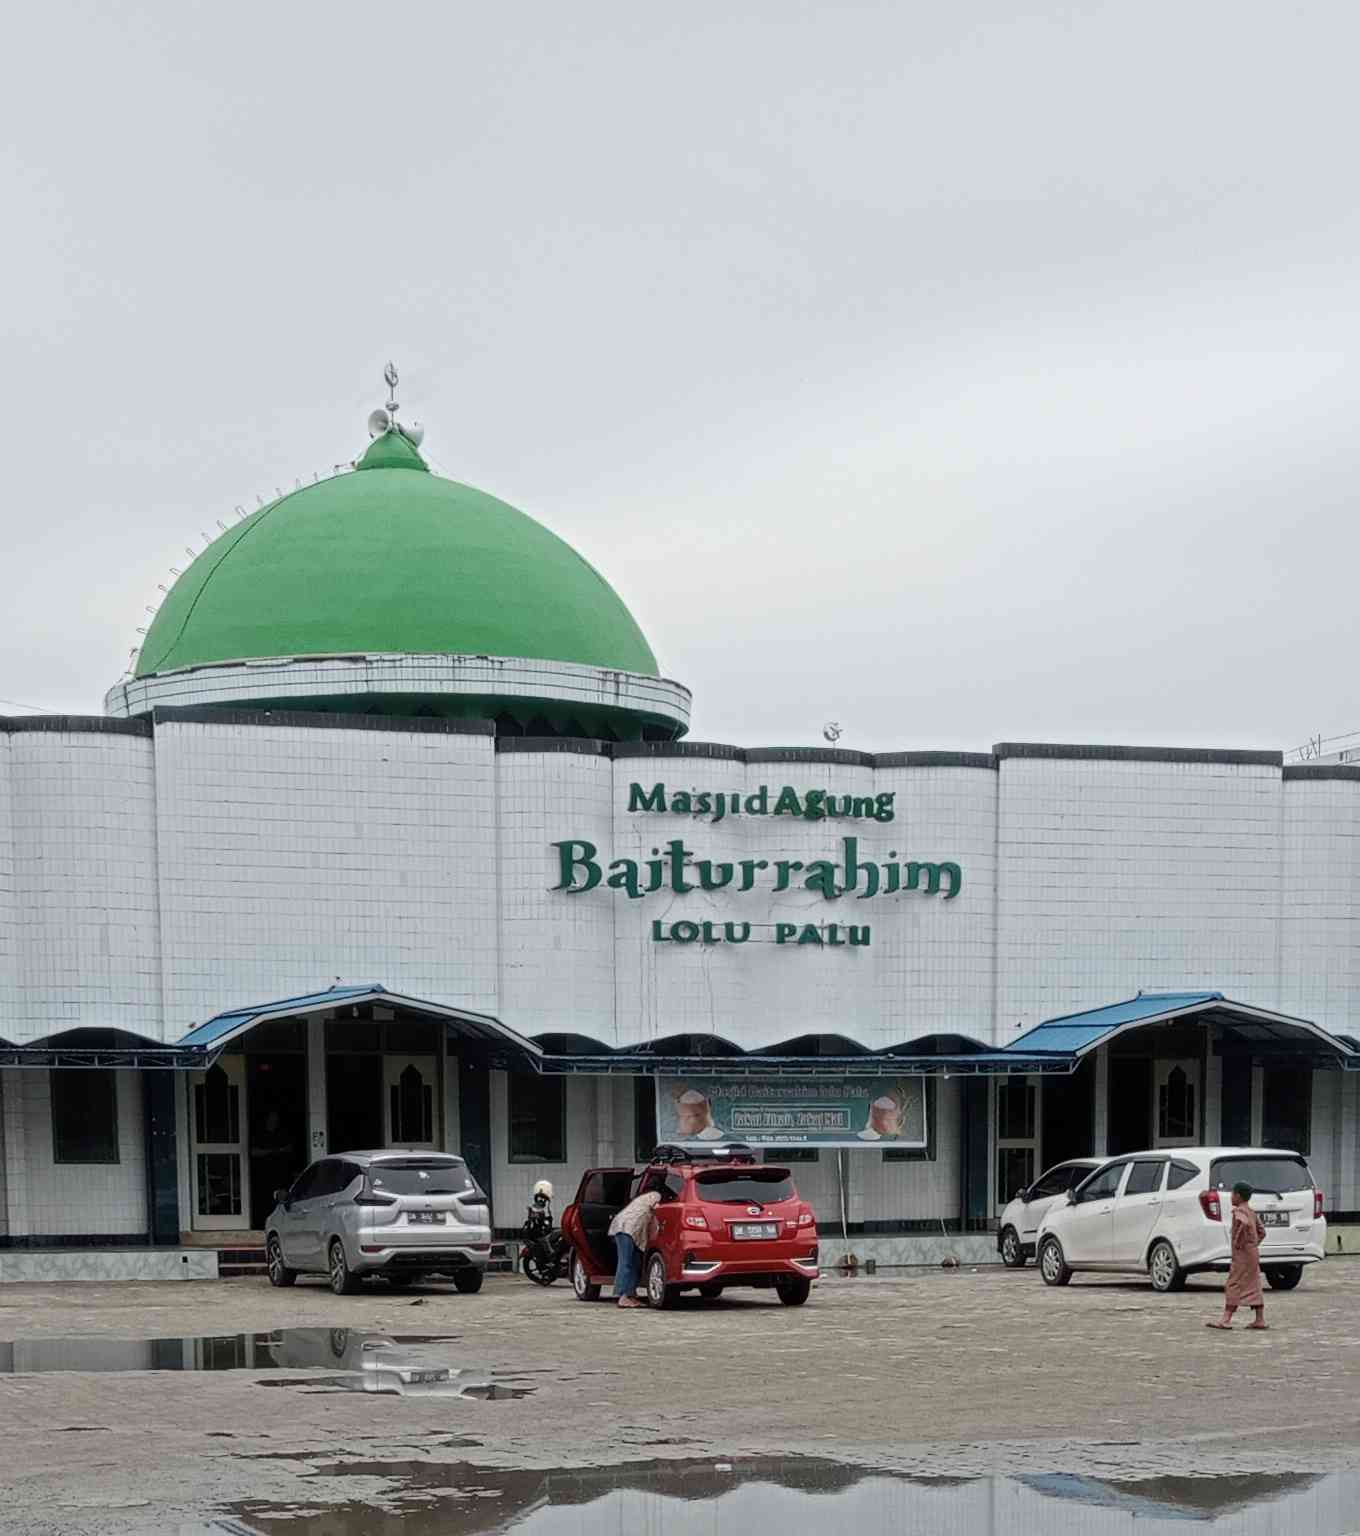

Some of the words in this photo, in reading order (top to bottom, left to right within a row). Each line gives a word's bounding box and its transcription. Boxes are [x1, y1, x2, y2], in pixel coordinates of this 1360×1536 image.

[626, 782, 769, 823] Masjid
[773, 785, 896, 822] Agung
[550, 836, 963, 900] Baiturrahim
[652, 919, 751, 944] LOLU
[776, 922, 871, 946] PALU
